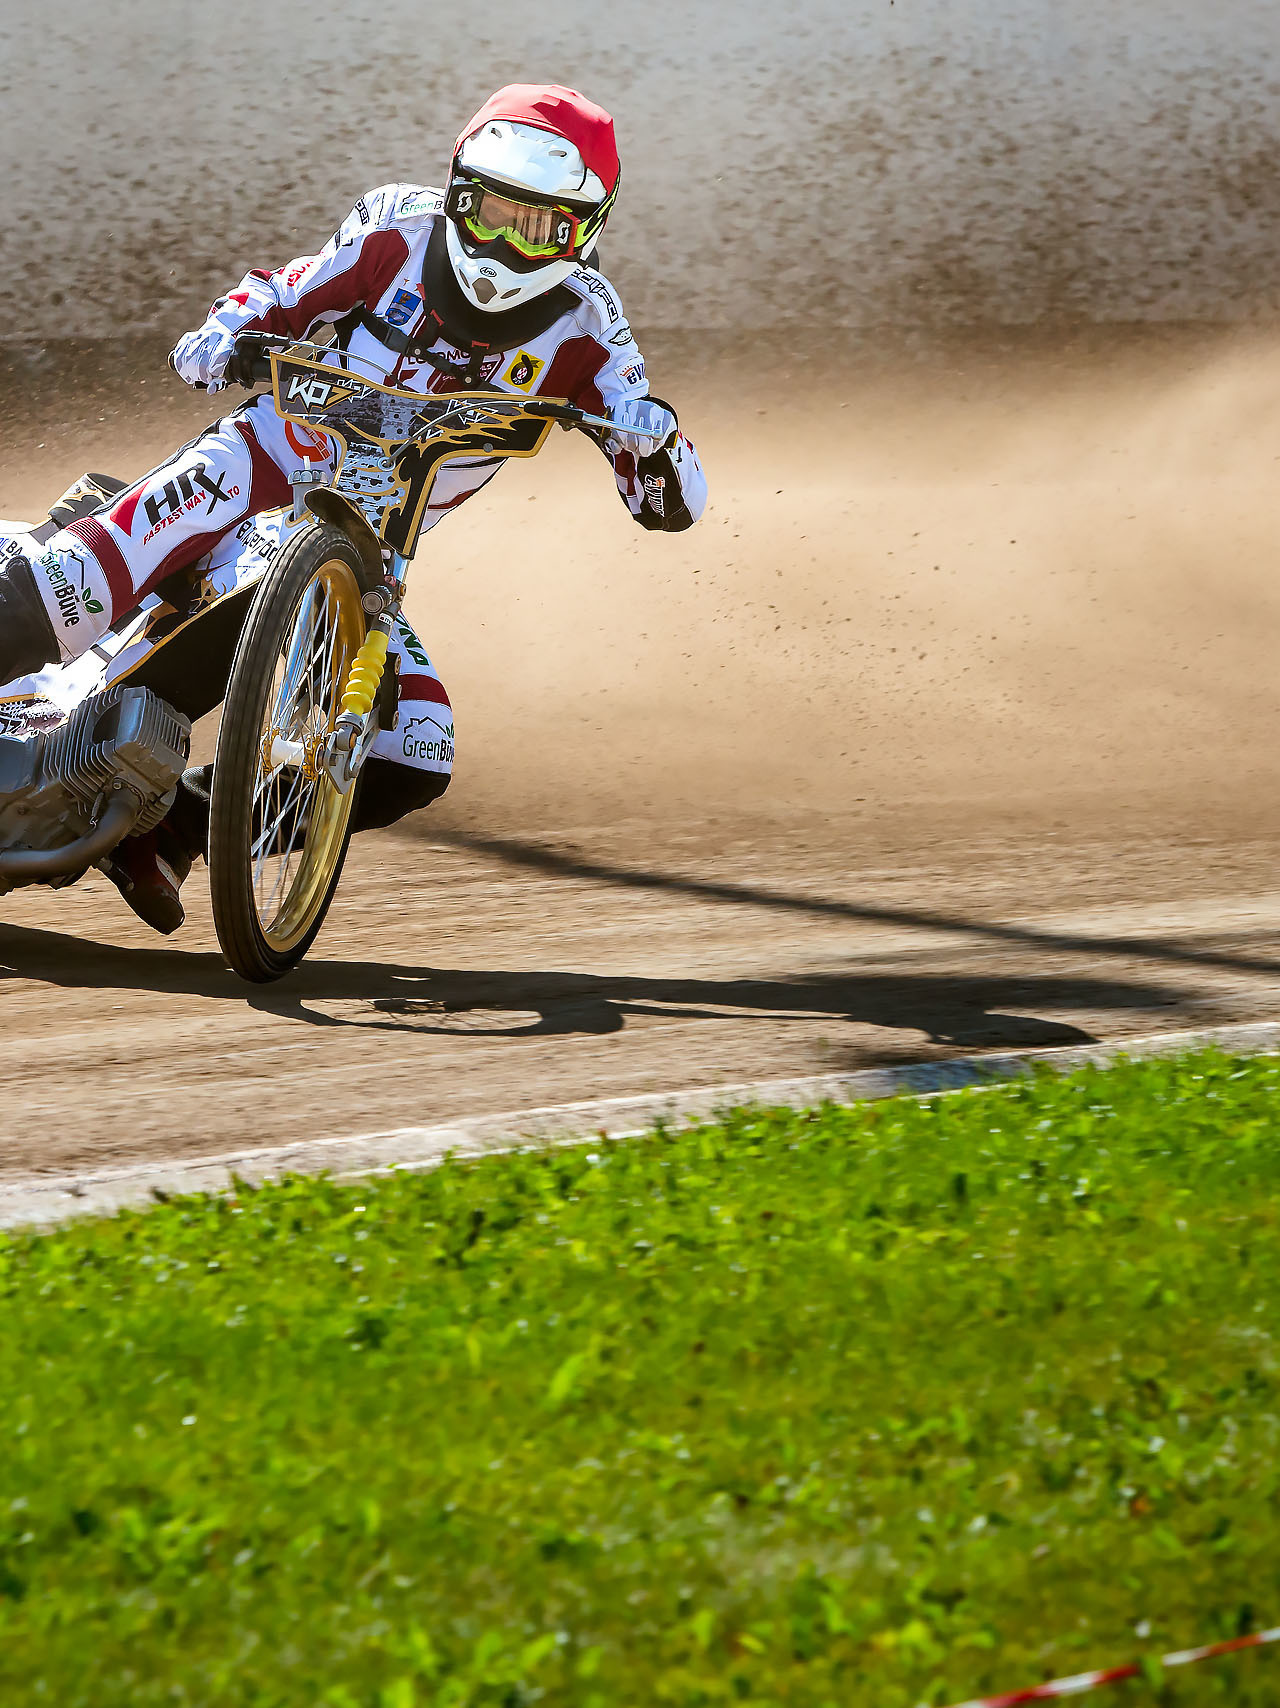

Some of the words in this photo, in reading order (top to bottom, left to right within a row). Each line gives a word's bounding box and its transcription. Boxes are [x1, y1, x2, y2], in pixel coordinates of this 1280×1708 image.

[143, 506, 184, 545] FASTEST
[184, 490, 207, 511] WAY
[228, 485, 240, 499] TO
